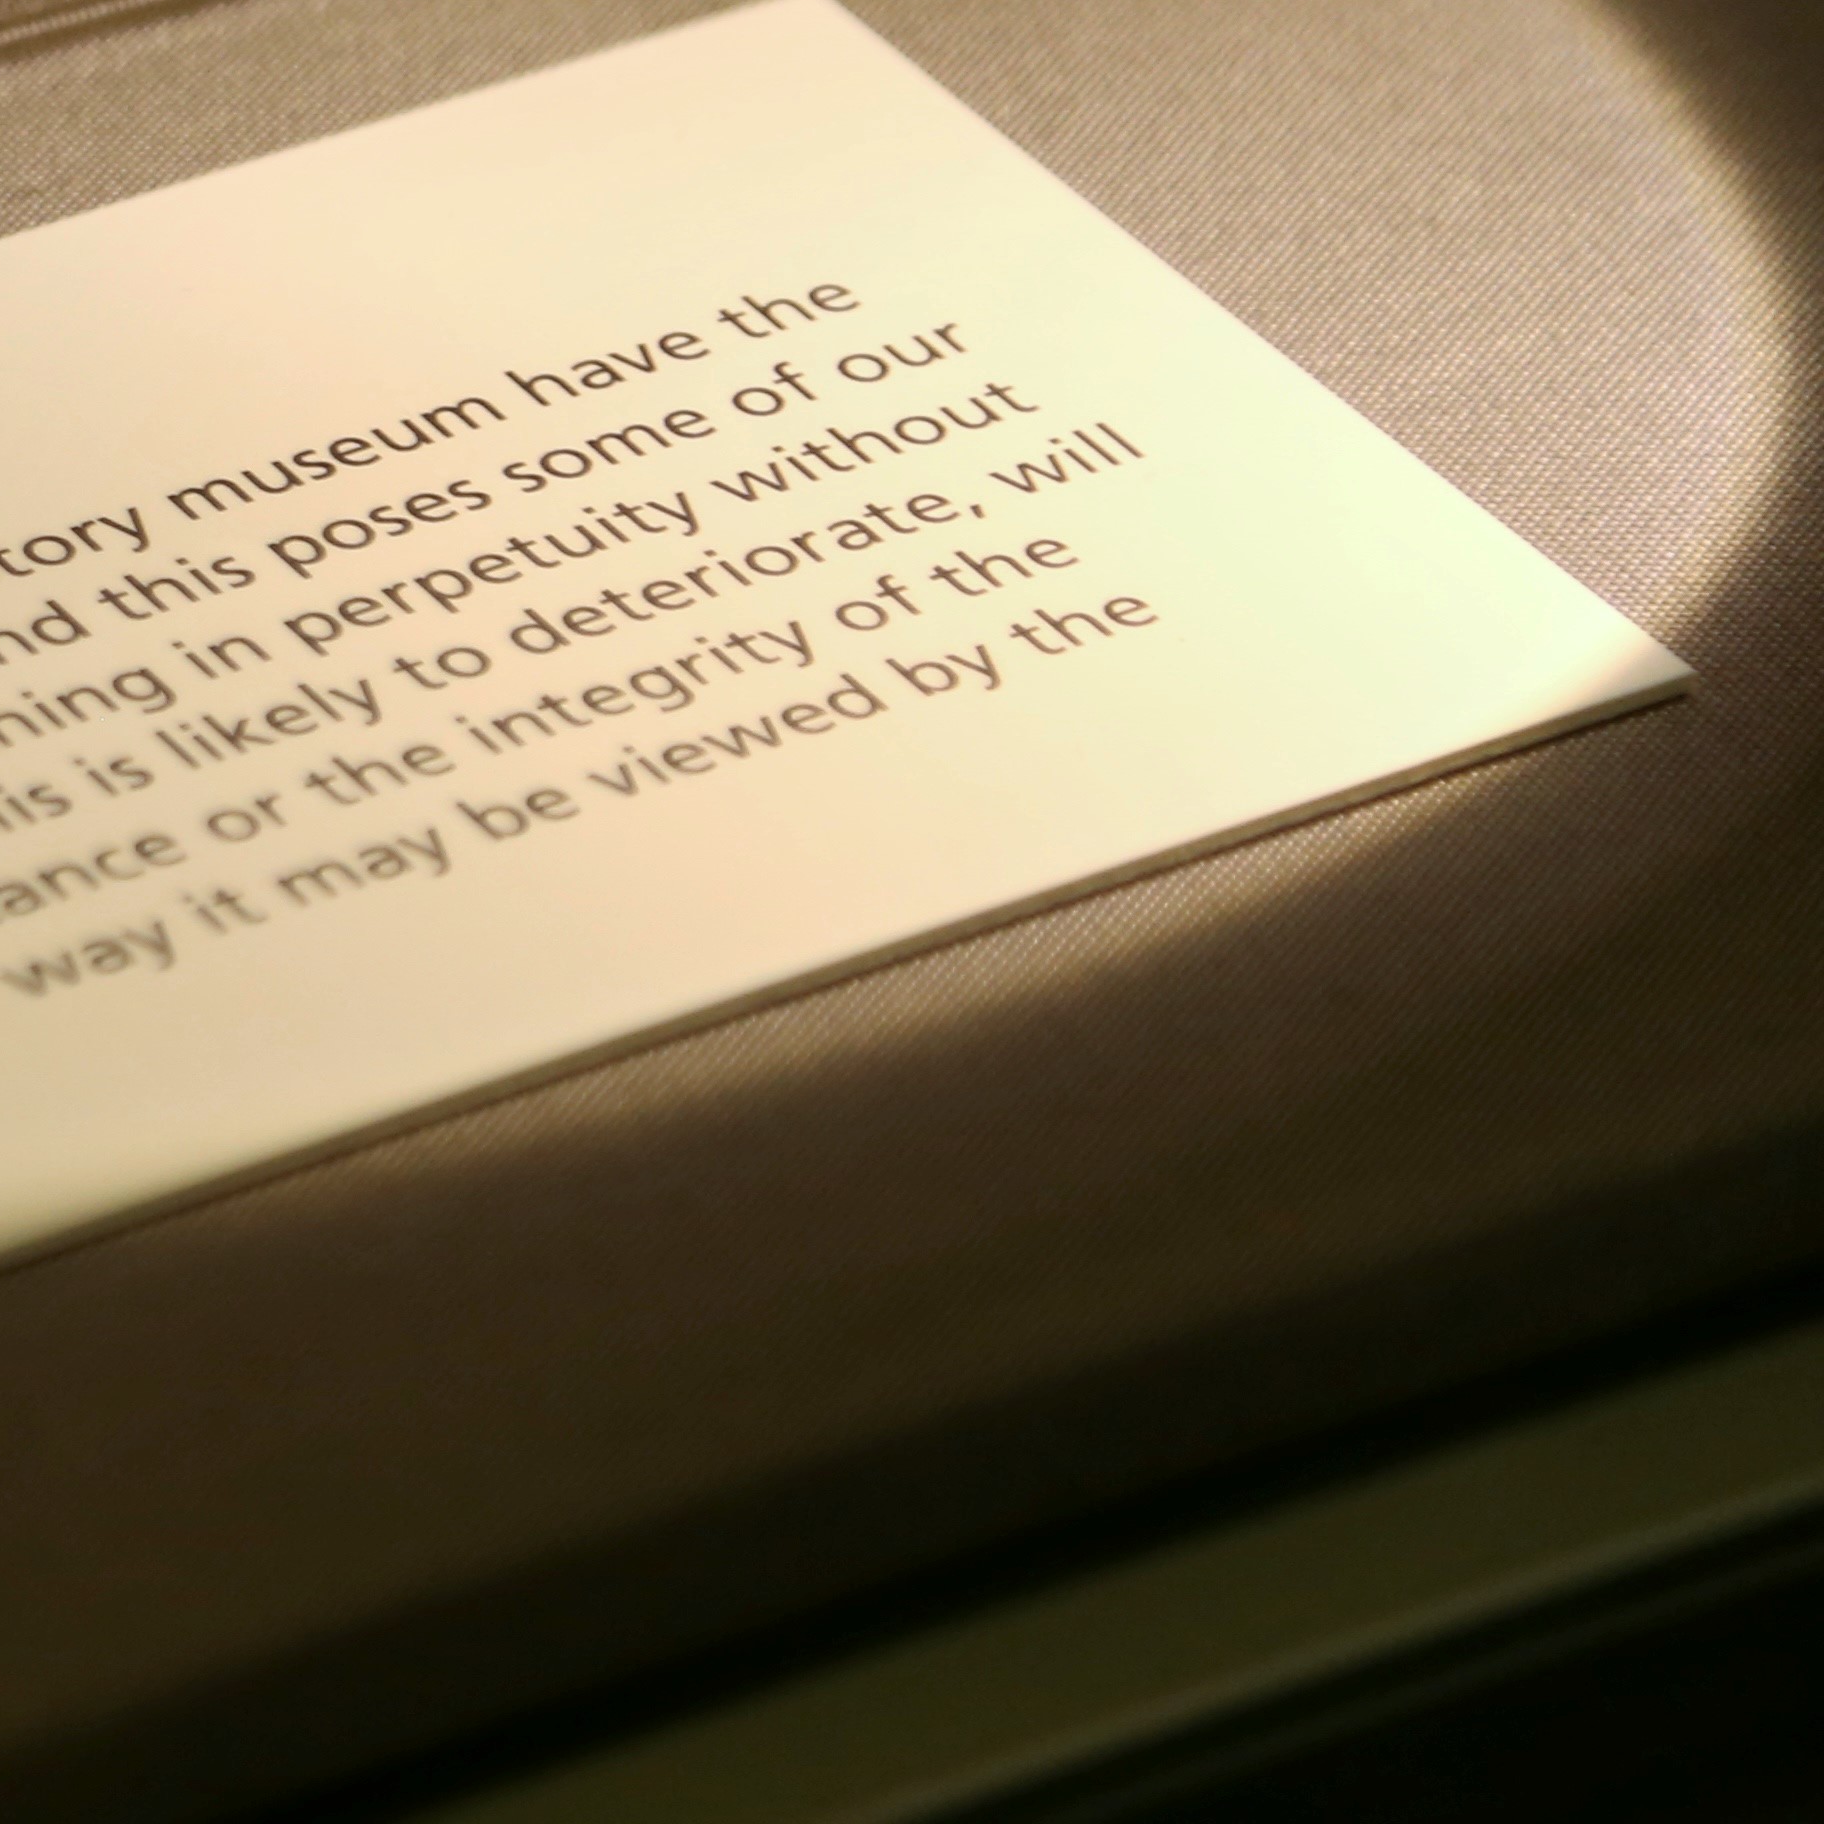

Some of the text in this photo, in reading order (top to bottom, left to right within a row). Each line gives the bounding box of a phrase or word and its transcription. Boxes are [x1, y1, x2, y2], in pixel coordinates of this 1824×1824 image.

[97, 556, 255, 620] this
[266, 479, 491, 578] poses
[501, 409, 715, 493] some
[730, 361, 816, 417] of
[835, 322, 965, 383] our
[166, 396, 505, 519] museum
[504, 331, 709, 406] have
[717, 283, 859, 338] the
[171, 635, 270, 679] in
[283, 491, 699, 655] perpetuity
[709, 383, 1037, 502] without
[72, 755, 154, 796] is
[154, 678, 381, 768] likely
[392, 645, 491, 690] to
[508, 493, 983, 654] deteriorate,
[988, 422, 1142, 493] will
[202, 792, 285, 842] or
[303, 743, 454, 805] the
[454, 620, 813, 753] integrity
[833, 573, 920, 631] of
[929, 538, 1078, 596] the
[0, 919, 175, 996] way
[181, 887, 266, 933] it
[274, 826, 450, 905] may
[454, 787, 578, 841] be
[587, 672, 887, 796] viewed
[884, 644, 1001, 696] by
[1009, 596, 1157, 655] the
